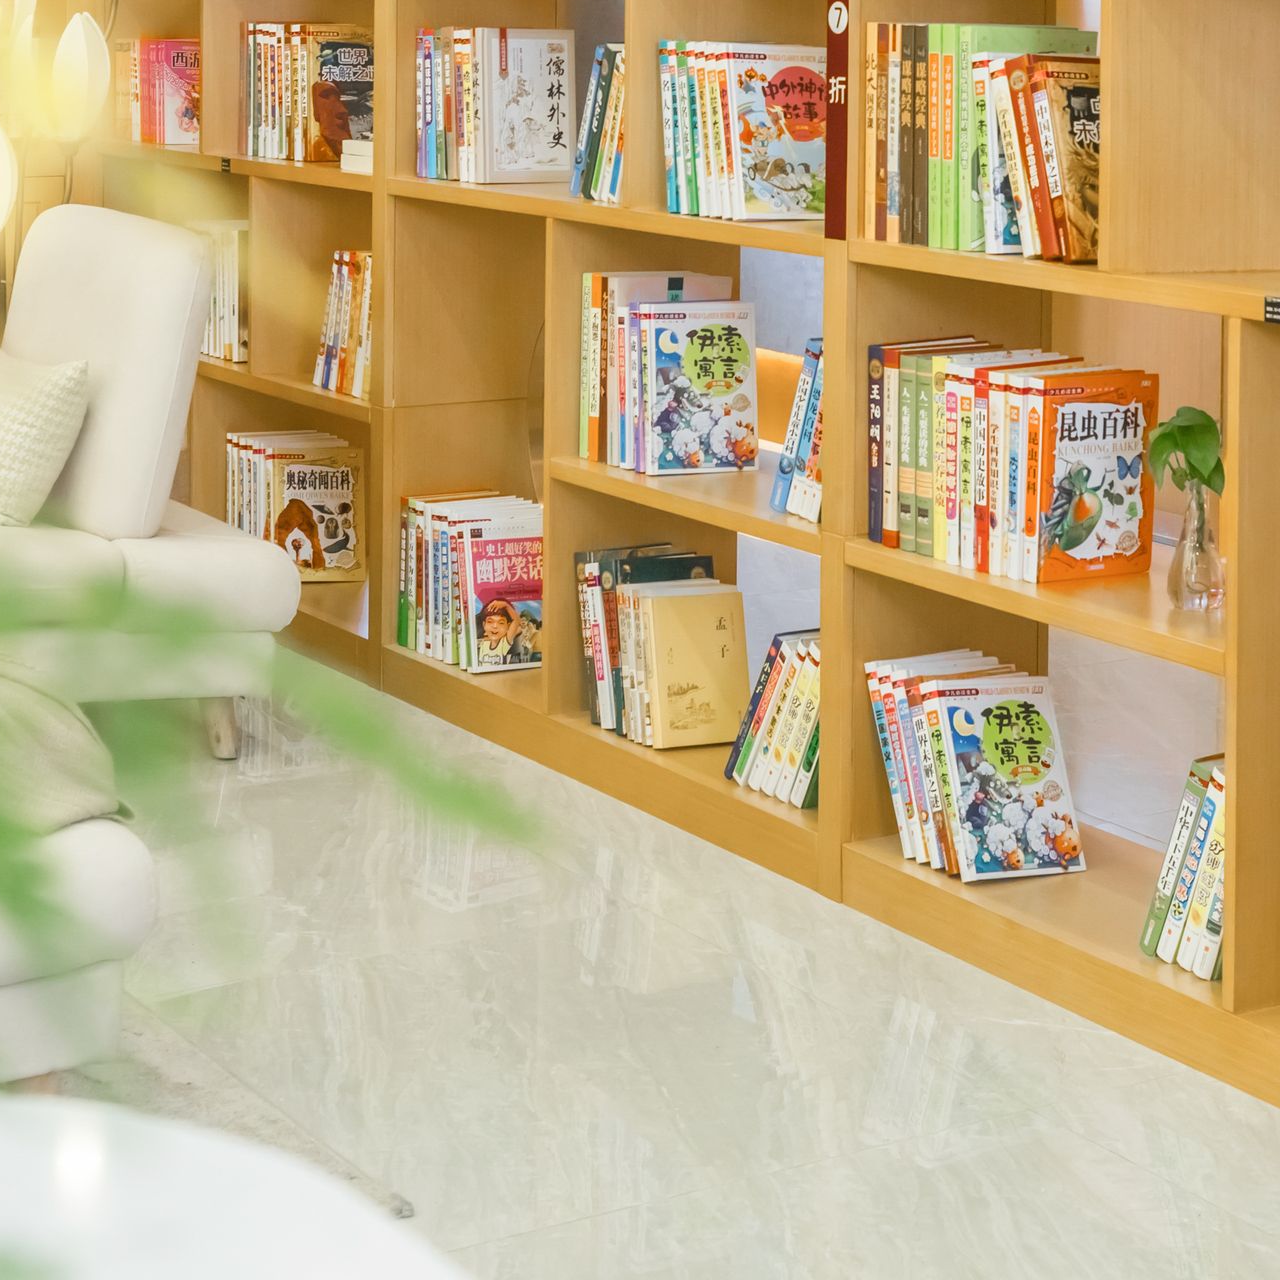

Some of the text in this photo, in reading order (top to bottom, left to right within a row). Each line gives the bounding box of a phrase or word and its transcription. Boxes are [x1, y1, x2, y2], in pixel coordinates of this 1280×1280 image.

[338, 48, 368, 65] 世界
[546, 57, 568, 150] 儒林外史
[782, 102, 819, 121] 故事
[685, 325, 743, 357] 伊索
[694, 357, 739, 384] 寓言
[1059, 406, 1141, 443] 昆虫百科
[286, 469, 351, 491] 奥秘奇闻百科
[1027, 430, 1039, 502] 昆虫百科
[486, 541, 543, 558] 史上超好笑的
[475, 556, 544, 584] 幽默笑话
[980, 701, 1041, 734] 伊索
[994, 738, 1042, 767] 寓言
